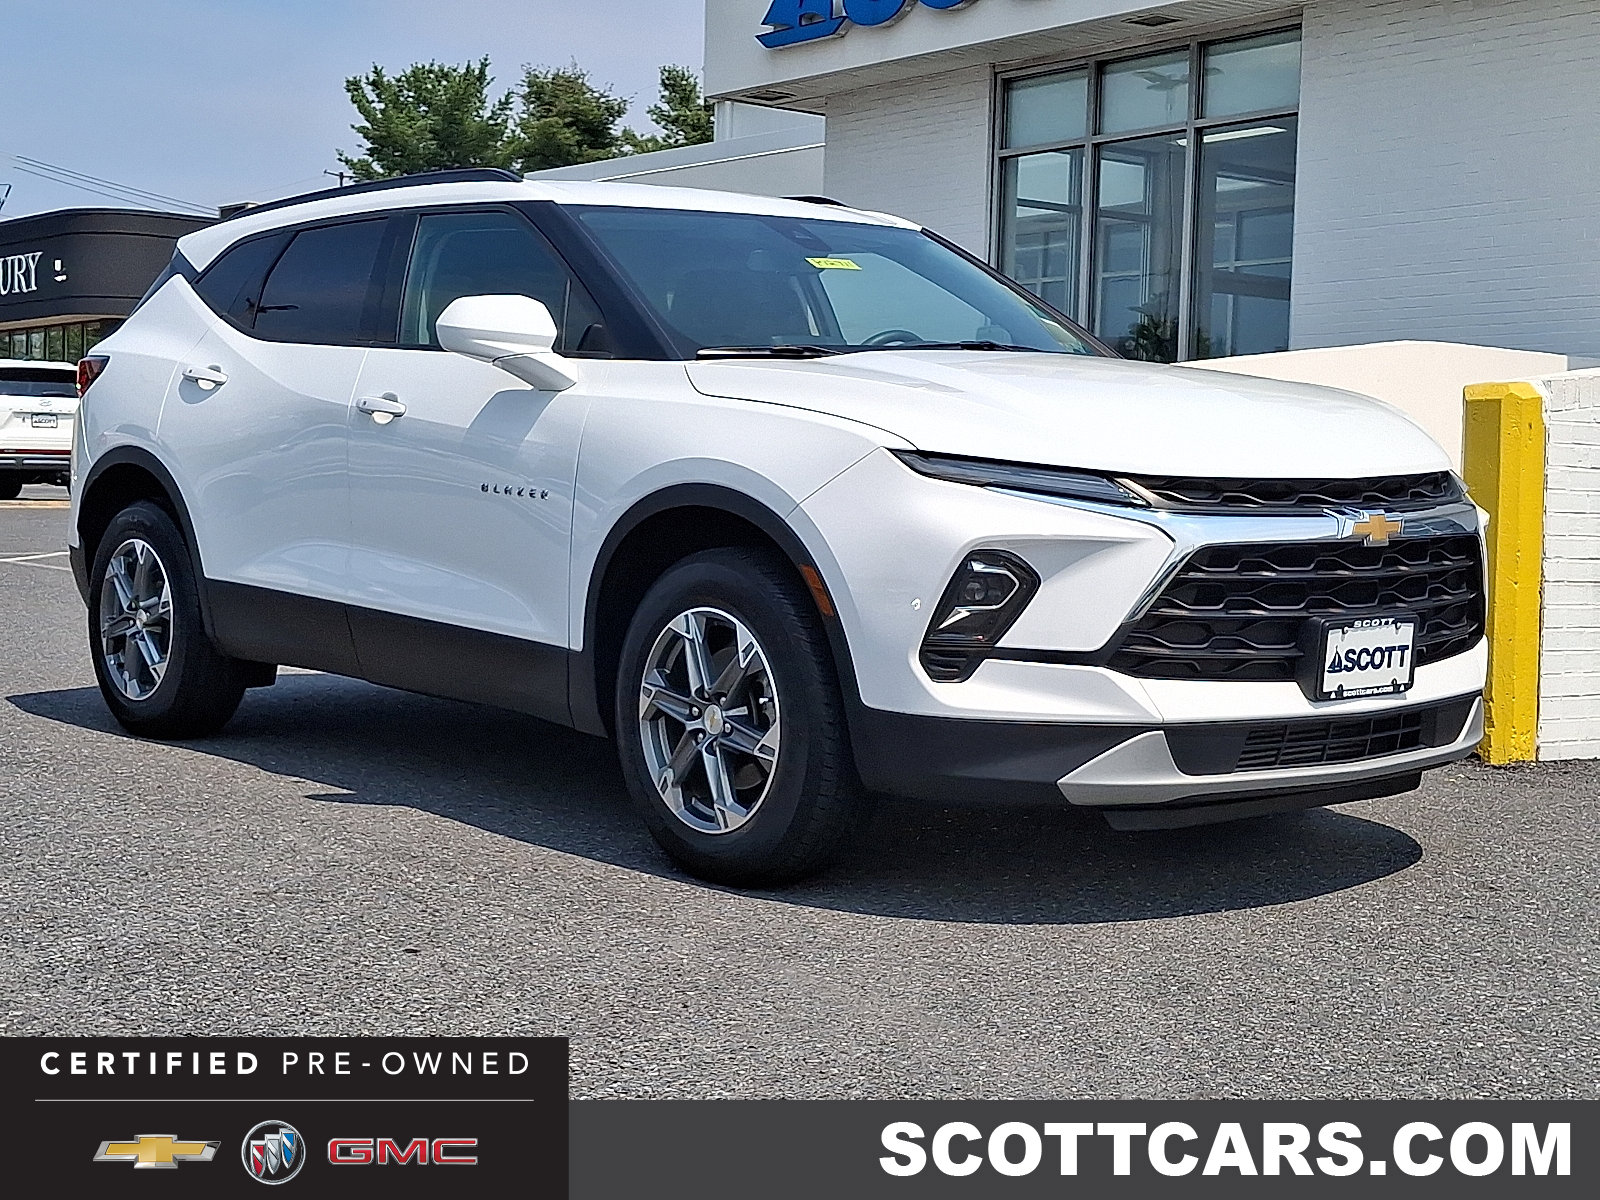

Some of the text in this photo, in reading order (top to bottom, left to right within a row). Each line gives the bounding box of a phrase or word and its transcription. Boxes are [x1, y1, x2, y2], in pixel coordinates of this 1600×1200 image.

[0, 252, 43, 296] URY
[481, 483, 549, 500] BLAZER
[1353, 618, 1395, 628] SCOTT
[1344, 645, 1409, 672] SCOTT
[1343, 686, 1393, 697] scottcars.com
